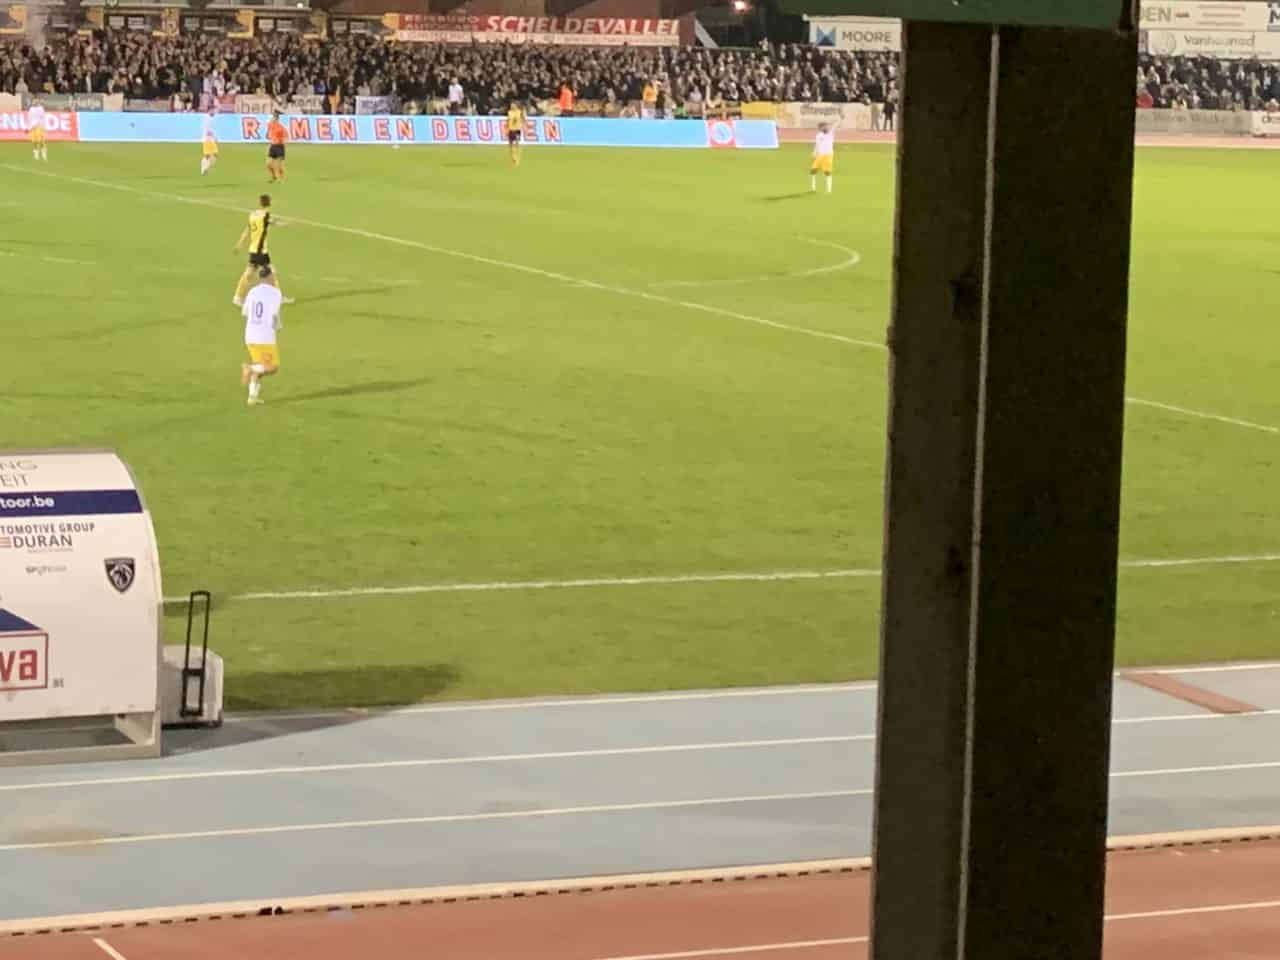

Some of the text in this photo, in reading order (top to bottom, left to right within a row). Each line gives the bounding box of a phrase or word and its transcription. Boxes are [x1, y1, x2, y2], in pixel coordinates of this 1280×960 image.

[486, 15, 680, 35] SCHELDEVALLEI
[841, 30, 893, 42] MOORE
[241, 117, 357, 140] RMEN
[373, 118, 415, 140] EN
[59, 522, 95, 533] GROUP
[13, 534, 73, 549] DURAN
